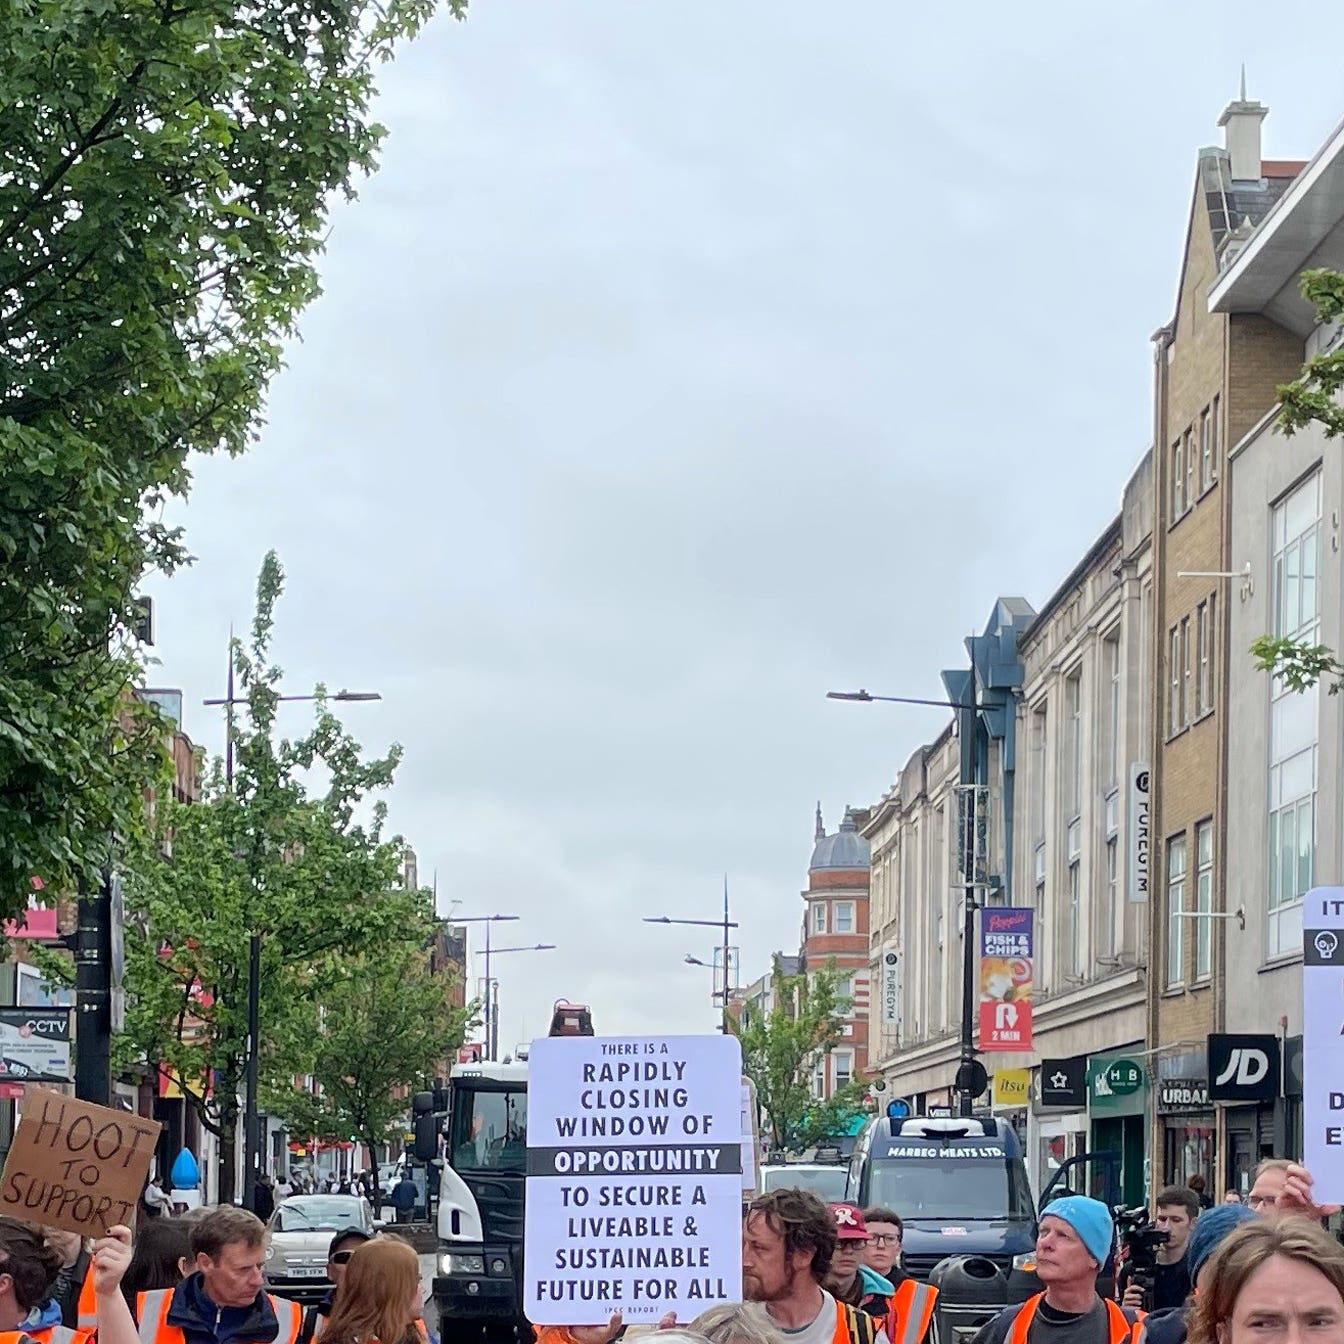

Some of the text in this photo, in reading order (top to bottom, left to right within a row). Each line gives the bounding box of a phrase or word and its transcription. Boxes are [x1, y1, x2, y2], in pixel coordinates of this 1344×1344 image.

[985, 935, 1028, 945] FISH &
[985, 945, 1029, 955] CHIPS
[886, 970, 895, 1020] PUREGYM
[26, 1020, 67, 1033] CCTV
[992, 1031, 1021, 1041] 2 MIN
[601, 1043, 669, 1056] THERE IS A
[583, 1061, 687, 1083] RAPIDLY
[1111, 1069, 1137, 1081] H B
[1215, 1048, 1269, 1086] JD
[1000, 1078, 1026, 1092] itsu
[581, 1088, 688, 1110] CLOSING
[33, 1101, 153, 1168] HOOT
[556, 1115, 714, 1137] WINDOW OF
[554, 1149, 721, 1174] OPPORTUNITY
[939, 1147, 978, 1158] MEATS
[979, 1147, 1006, 1157] LTD.
[59, 1158, 100, 1186] TO
[3, 1171, 135, 1230] SUPPORT
[561, 1185, 707, 1207] TO SECURE A
[568, 1216, 698, 1238] LIVEABLE &
[835, 1207, 857, 1226] R
[555, 1247, 710, 1270] SUSTAINABLE
[536, 1278, 728, 1302] FUTURE FOR ALL
[628, 1306, 659, 1314] REPORT
